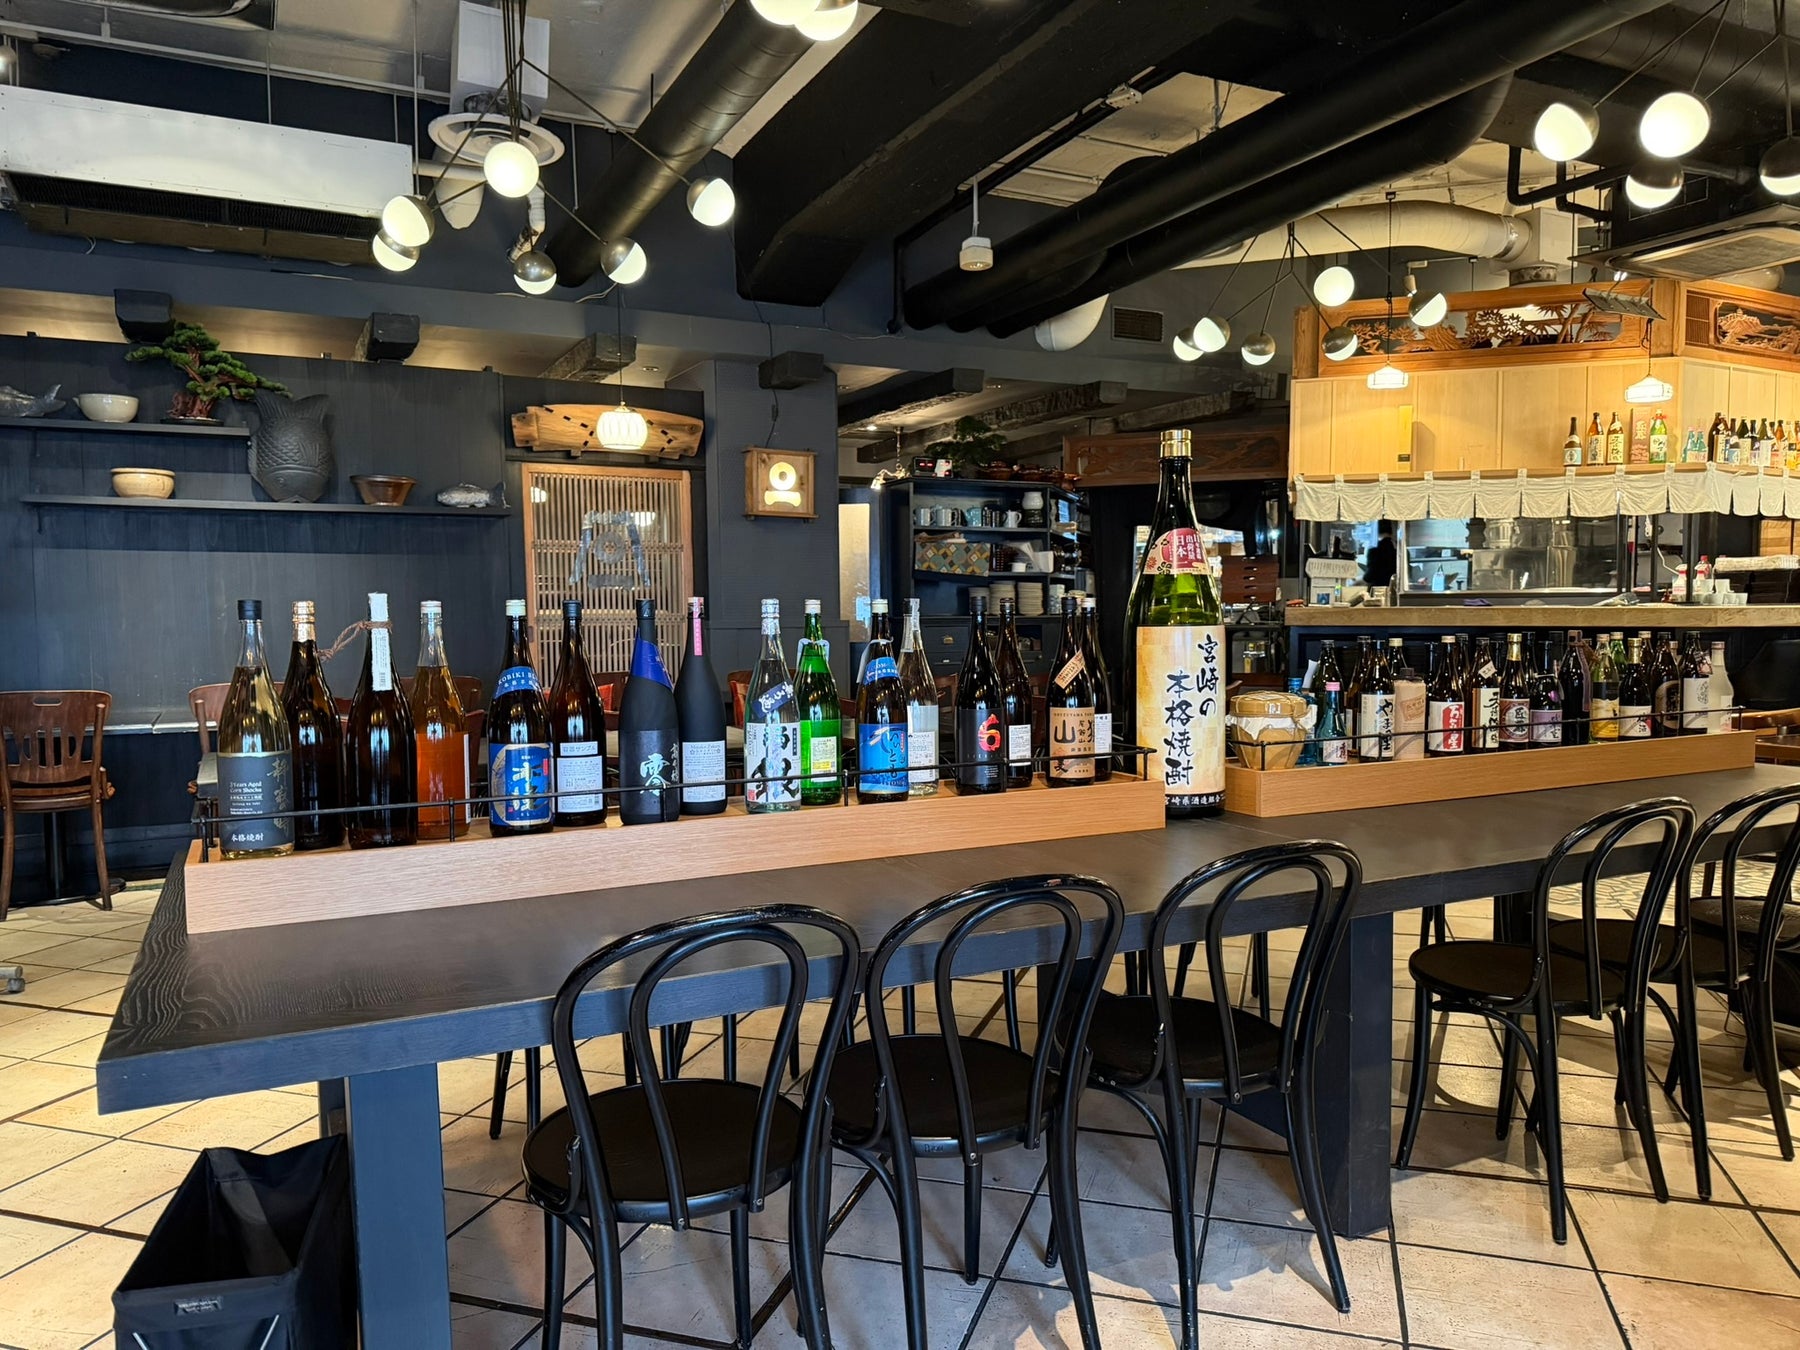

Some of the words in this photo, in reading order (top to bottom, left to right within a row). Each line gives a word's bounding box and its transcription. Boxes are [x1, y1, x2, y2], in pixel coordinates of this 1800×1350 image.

[498, 671, 525, 685] KOBIKI
[1196, 633, 1219, 717] 宮崎の
[1163, 670, 1195, 786] 本格焼酎
[231, 833, 264, 842] 本格焼酎
